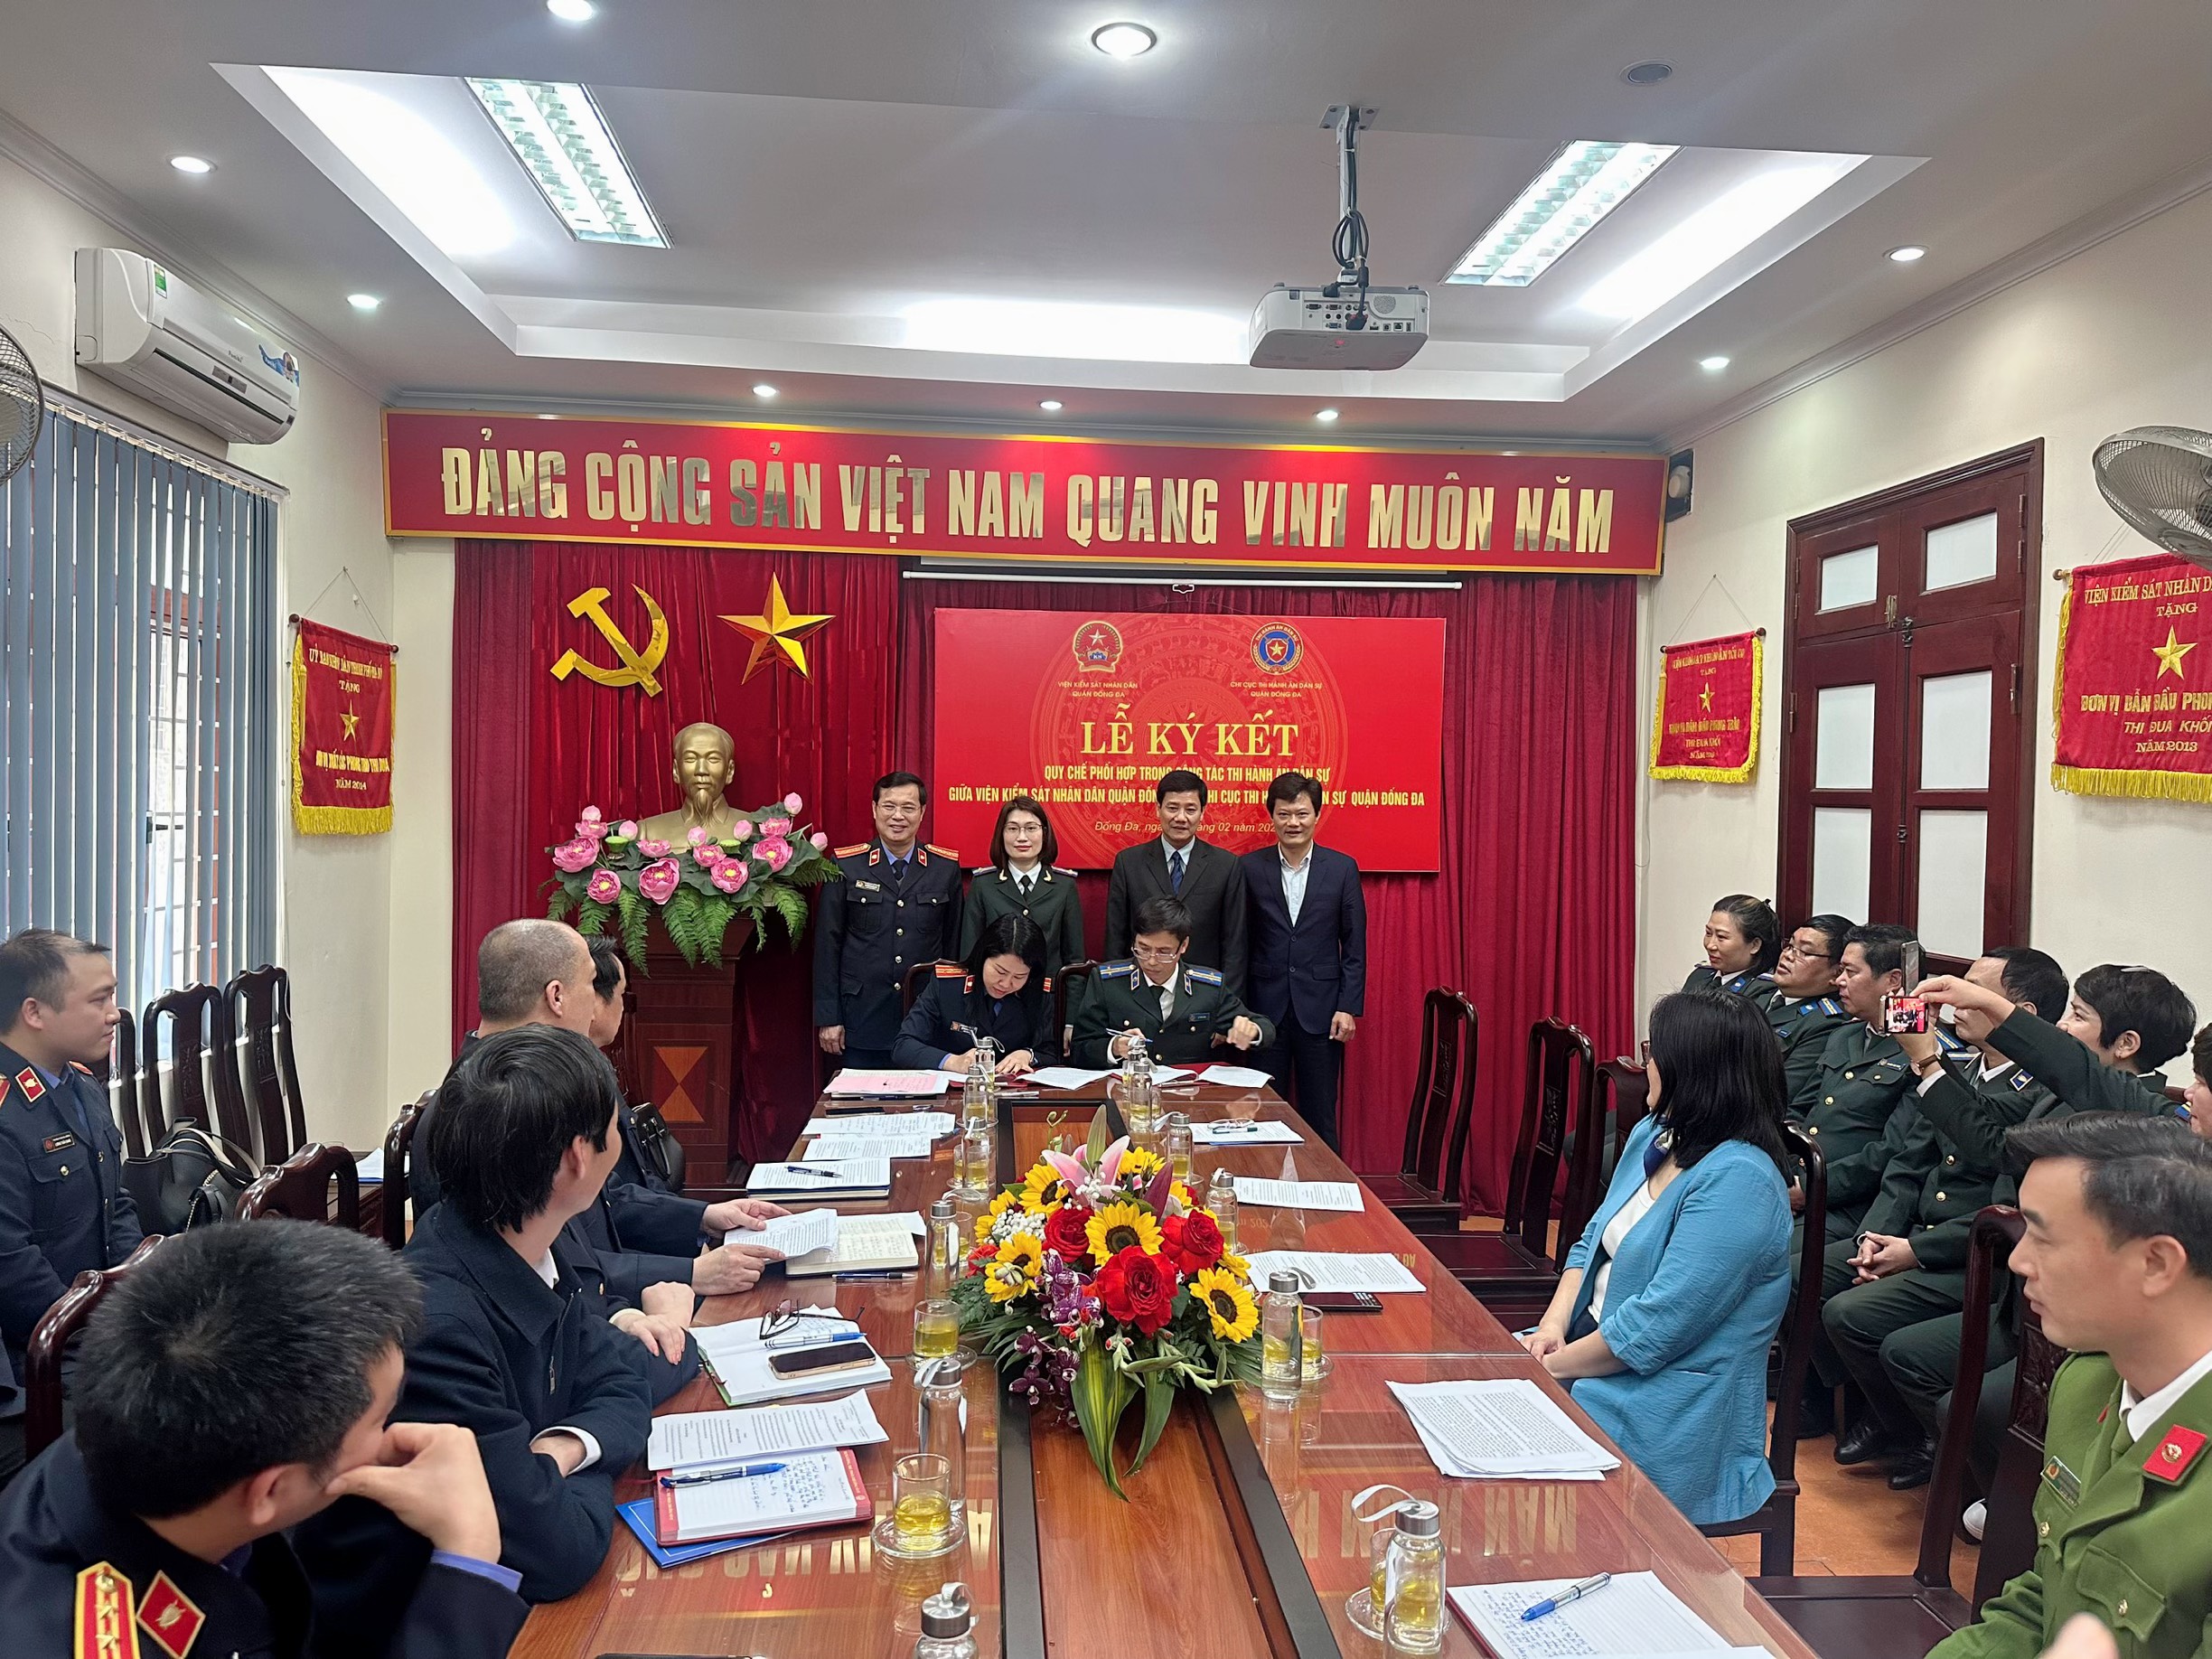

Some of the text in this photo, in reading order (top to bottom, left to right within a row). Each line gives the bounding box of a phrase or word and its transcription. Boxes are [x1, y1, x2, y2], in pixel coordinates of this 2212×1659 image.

[441, 427, 1615, 554] ĐẢNG CỘNG SẢN VIỆT NAM QUANG VINH MUÔN NĂM
[2085, 584, 2109, 607] VIỆN
[2111, 576, 2140, 601] KIỂM
[2141, 578, 2162, 600] SÁT
[2156, 602, 2198, 618] TẶNG
[2109, 695, 2121, 716] VỊ
[2153, 687, 2178, 711] ĐẦU
[1080, 703, 1298, 756] LỄ KÝ KẾT
[2123, 721, 2145, 735] THI
[2149, 720, 2172, 733] ĐUA
[2135, 739, 2166, 753] NĂM
[1045, 765, 1064, 781] QUY
[1067, 761, 1087, 780] CHẾ
[1090, 761, 1114, 781] PHỐI
[1116, 765, 1137, 783] HỢP
[1205, 764, 1224, 782] TÁC
[1227, 767, 1242, 782] THI
[1245, 764, 1273, 782] HÀNH
[1316, 767, 1330, 785] SỰ
[335, 777, 351, 789] NĂM
[949, 783, 973, 801] GIỮA
[976, 784, 999, 805] VIỆN
[1031, 784, 1050, 801] SÁT
[1053, 785, 1082, 802] NHÂN
[1084, 785, 1105, 802] DÂN
[1108, 786, 1136, 806] QUẬN
[1207, 790, 1218, 803] HI
[1221, 790, 1241, 807] CỤC
[1243, 790, 1259, 804] THI
[1332, 790, 1347, 808] SỰ
[1352, 788, 1379, 809] QUẬN
[1381, 787, 1409, 806] ĐỐNG
[1411, 792, 1425, 806] ĐA
[1095, 820, 1121, 833] Đống
[1125, 821, 1141, 832] Đa,
[1218, 822, 1231, 831] 02
[1233, 822, 1255, 832] năm
[1258, 822, 1276, 832] 202
